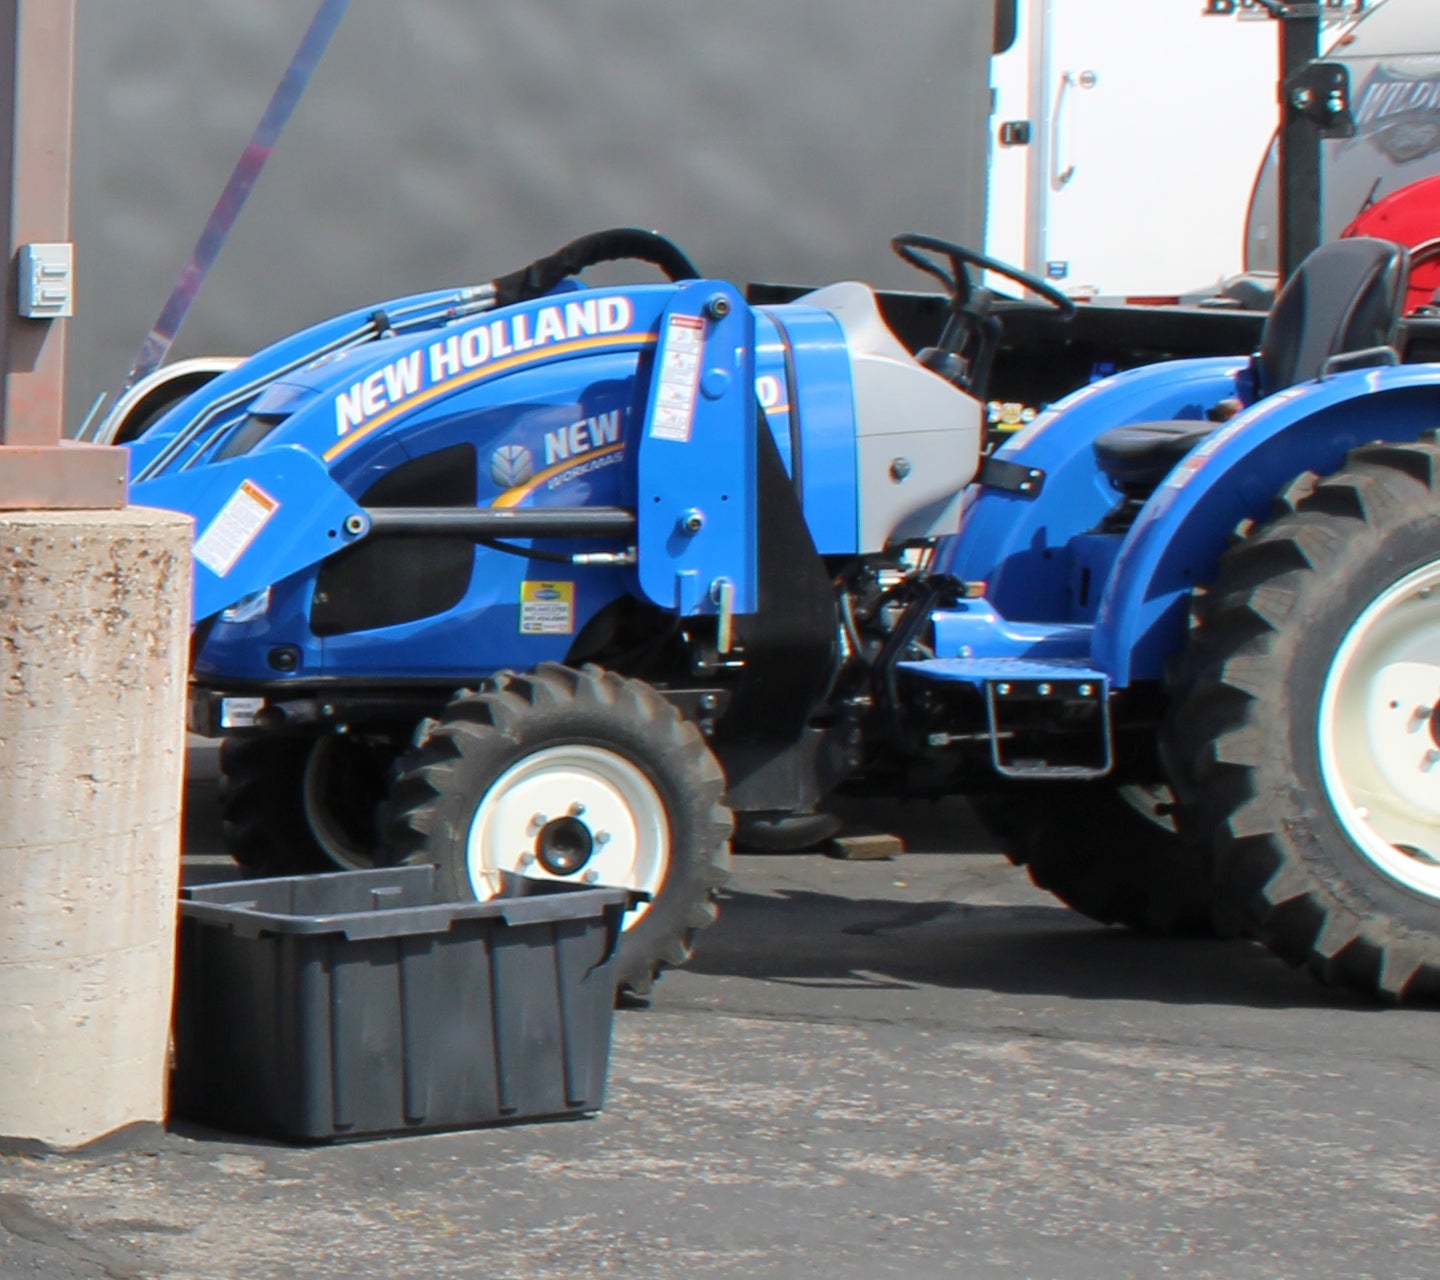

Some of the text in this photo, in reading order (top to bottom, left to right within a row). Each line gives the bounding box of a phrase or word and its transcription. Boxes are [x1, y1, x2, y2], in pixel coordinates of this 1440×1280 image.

[334, 349, 423, 437] NEW
[429, 296, 633, 383] HOLLAND
[544, 409, 621, 466] NEW
